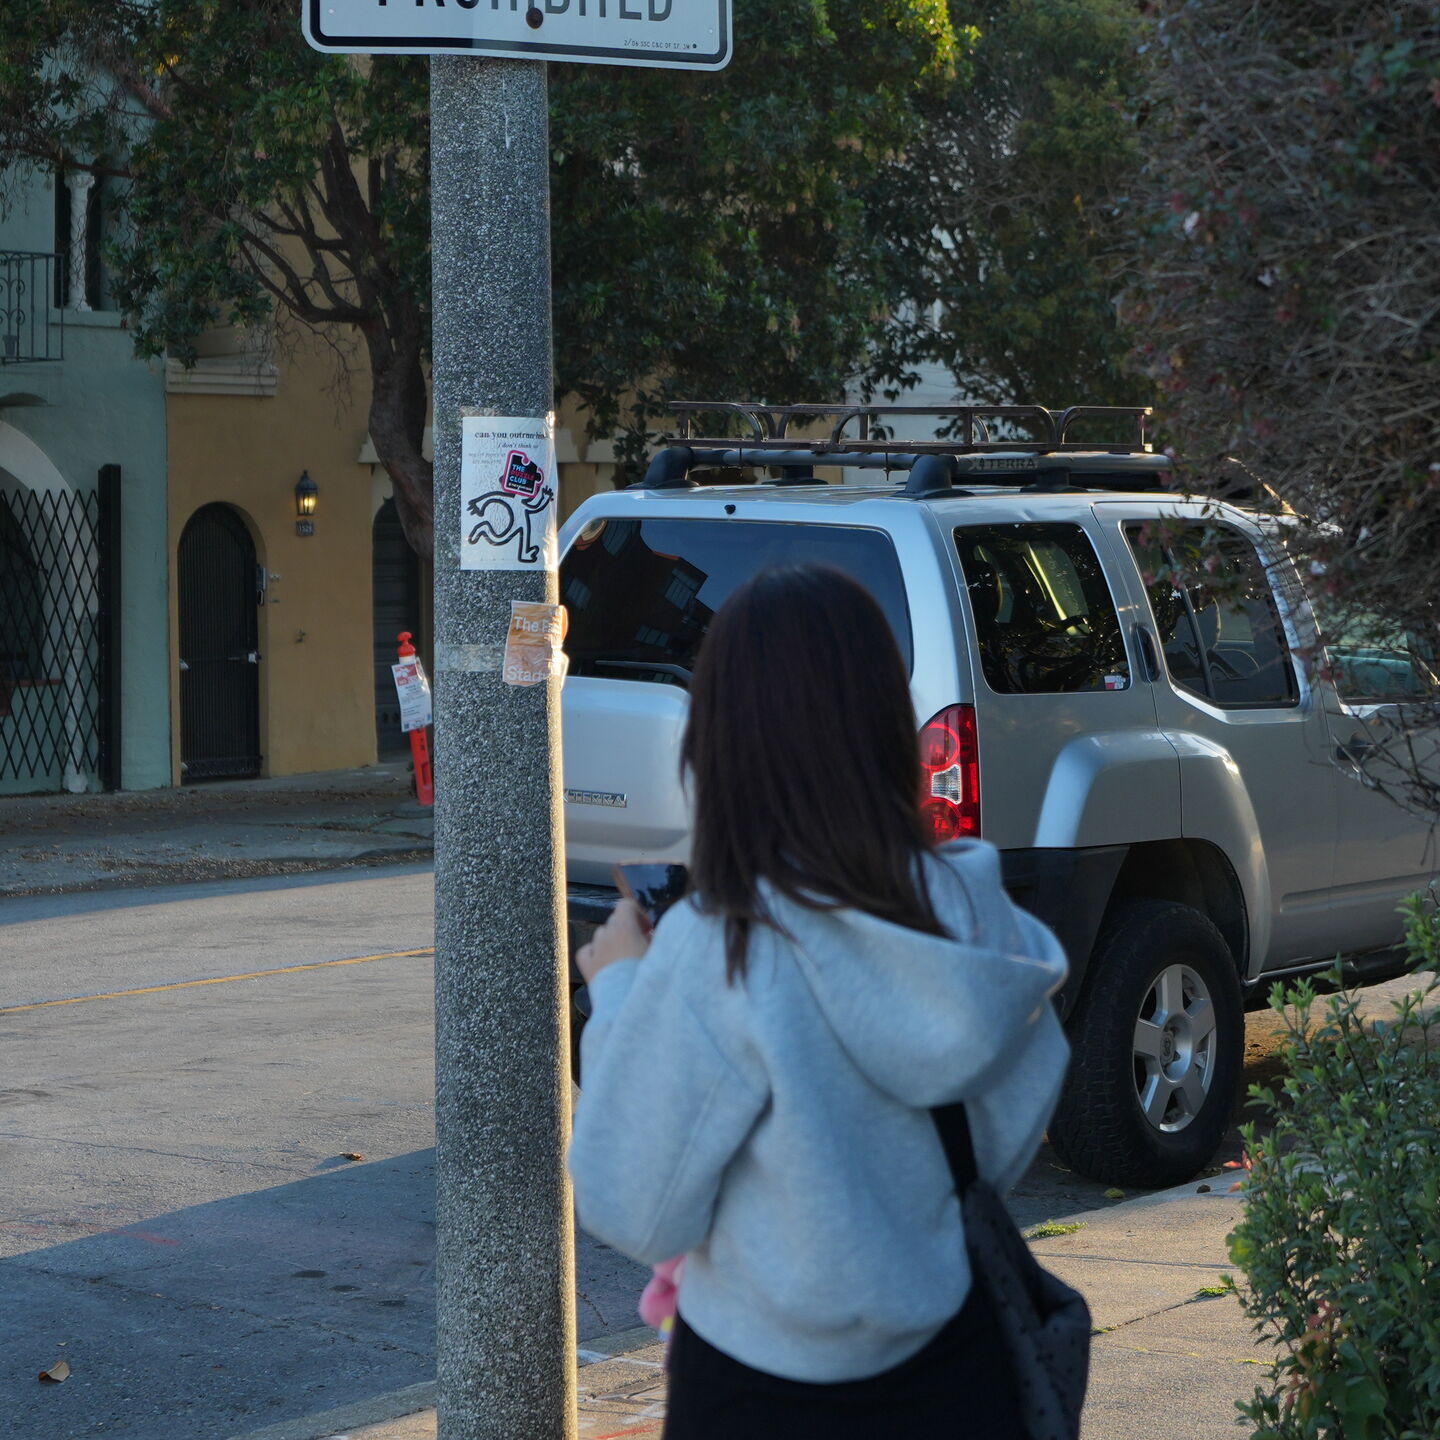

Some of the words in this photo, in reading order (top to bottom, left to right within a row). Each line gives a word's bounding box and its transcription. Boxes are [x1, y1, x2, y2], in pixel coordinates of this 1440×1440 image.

[492, 432, 507, 440] you
[511, 463, 526, 472] THE
[509, 475, 528, 485] CLUB
[513, 615, 539, 633] The
